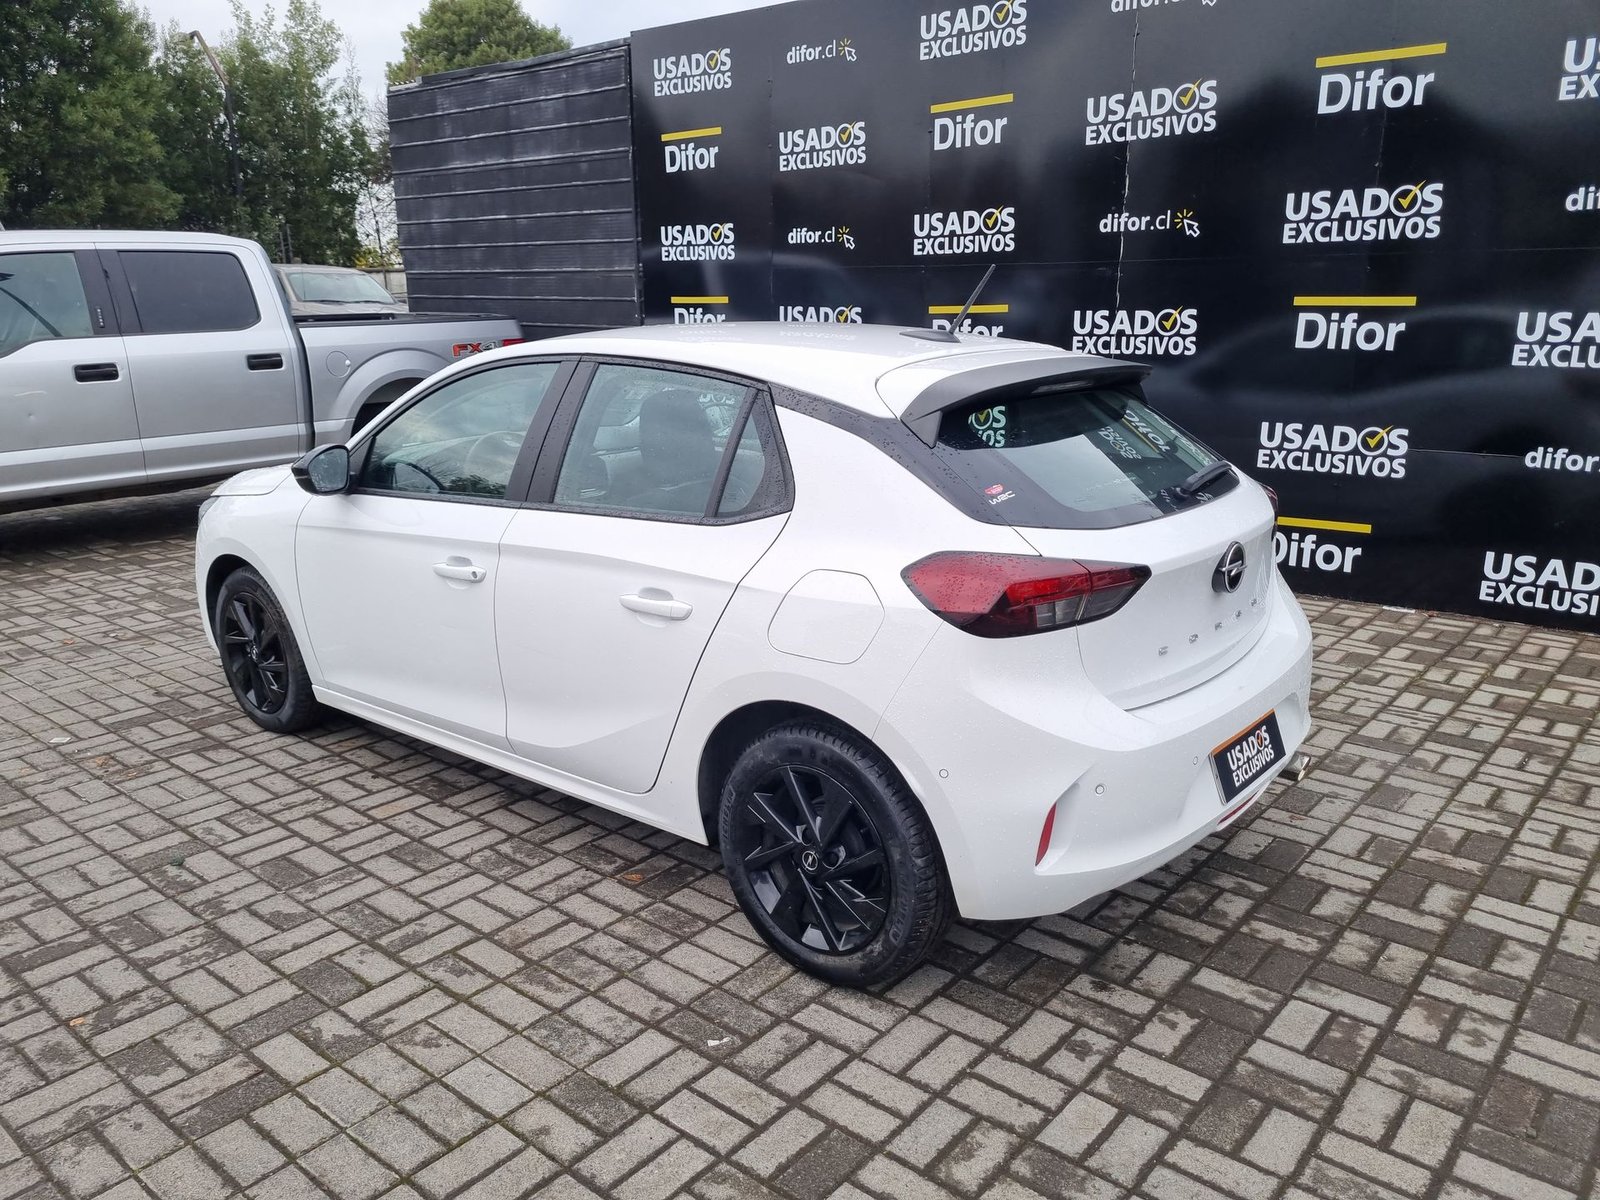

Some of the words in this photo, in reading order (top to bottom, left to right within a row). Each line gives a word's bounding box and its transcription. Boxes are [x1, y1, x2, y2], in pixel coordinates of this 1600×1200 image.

[919, 0, 1027, 40] USADOS
[786, 39, 836, 64] difor.cl
[919, 25, 1027, 61] EXCLUSIVOS
[653, 48, 731, 79] USADOS
[653, 73, 732, 97] EXCLUSIVOS
[1318, 68, 1435, 115] Difor
[1086, 79, 1217, 124] USADOS
[779, 121, 866, 154] USADOS
[933, 113, 1008, 151] Difor
[1085, 110, 1217, 146] EXCLUSIVOS
[664, 142, 718, 173] Difor
[779, 147, 867, 172] EXCLUSIVOS
[1285, 182, 1444, 221] USADOS
[660, 223, 735, 246] USADOS
[787, 226, 835, 245] difor.cl
[913, 207, 1015, 236] USADOS
[1099, 210, 1171, 233] difor.cl
[1282, 216, 1441, 244] EXCLUSIVOS
[661, 244, 735, 262] EXCLUSIVOS
[913, 233, 1015, 256] EXCLUSIVOS
[674, 307, 726, 324] Difor
[779, 304, 862, 324] USADOS
[932, 318, 1004, 338] Dfor
[1073, 308, 1198, 336] USADOS
[1071, 335, 1198, 356] EXCLUSIVOS
[1294, 312, 1406, 351] Difor
[1259, 421, 1409, 456] USADOS
[1256, 449, 1407, 479] EXCLUSIVOS
[988, 490, 1016, 505] WRC
[1227, 725, 1271, 771] USADOS
[1232, 749, 1275, 788] EXCLUSIVOS
